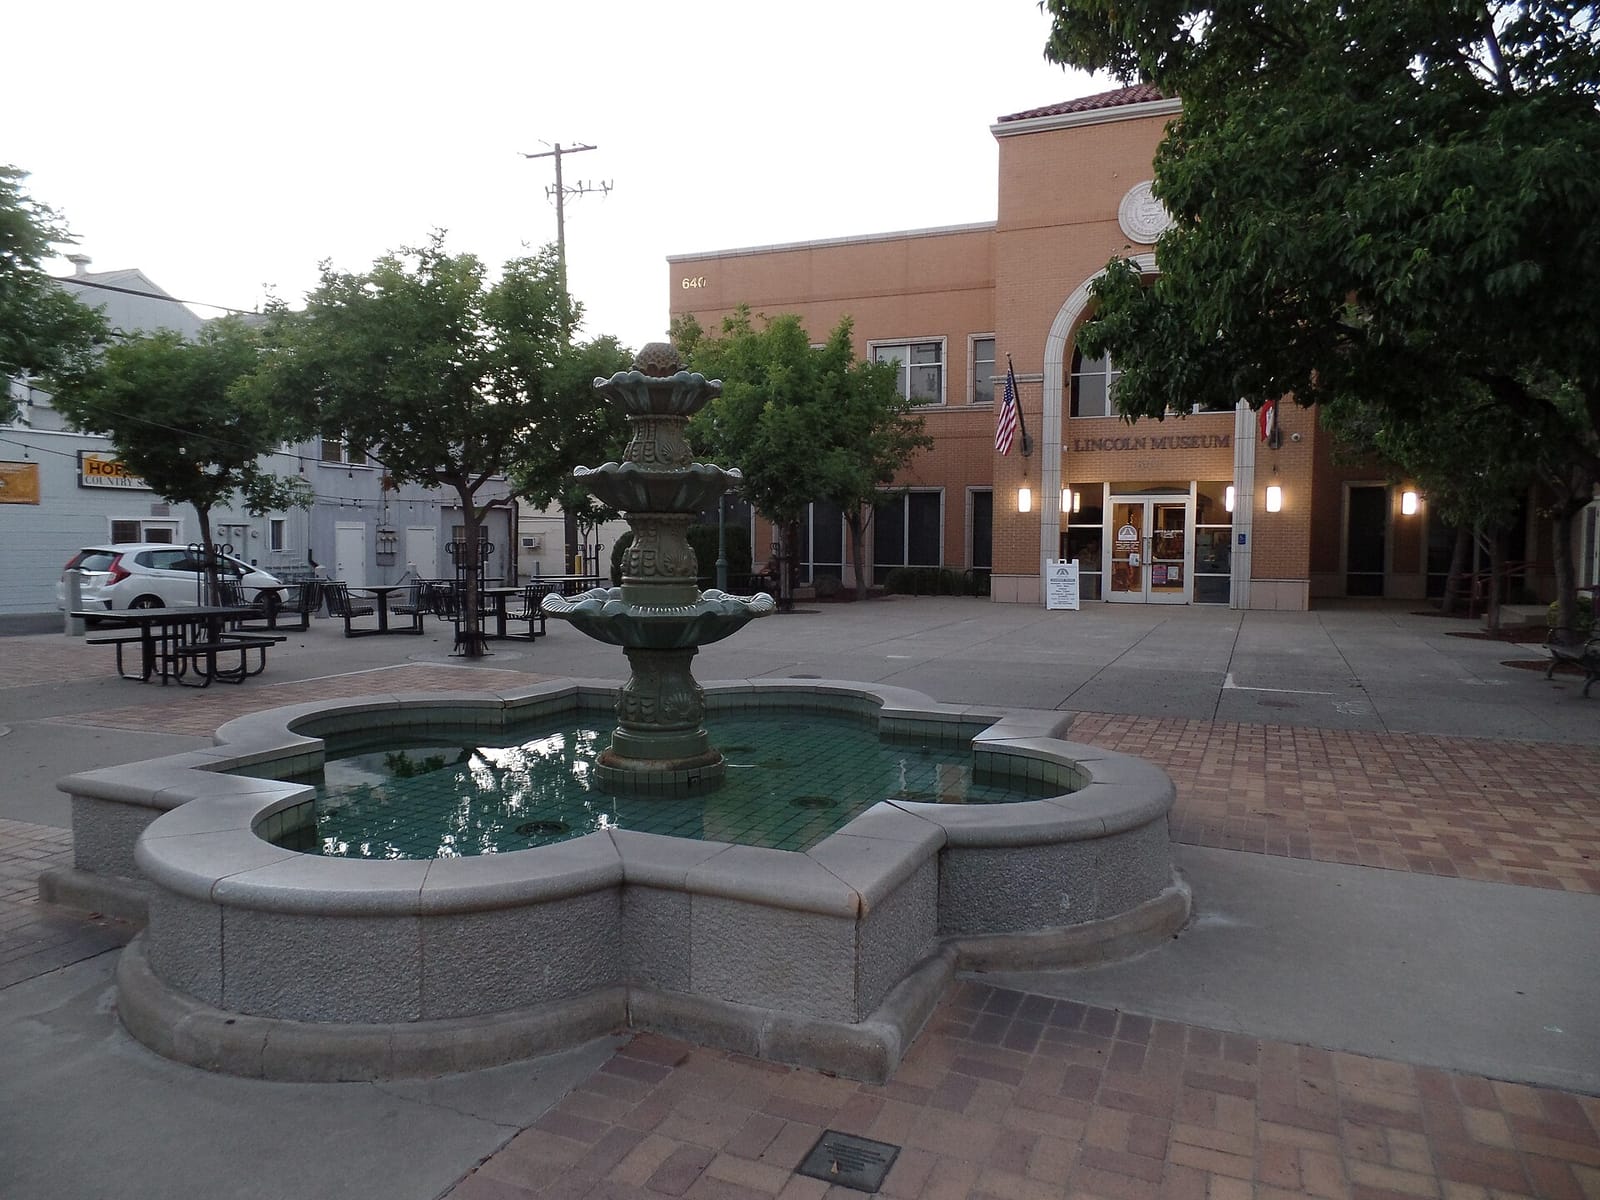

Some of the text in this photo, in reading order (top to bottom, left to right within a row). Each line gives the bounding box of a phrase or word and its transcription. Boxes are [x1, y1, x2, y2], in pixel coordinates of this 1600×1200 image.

[682, 277, 706, 289] 640
[1074, 435, 1230, 451] LINCOLN MUSEUM
[85, 475, 132, 487] COUNTRY
